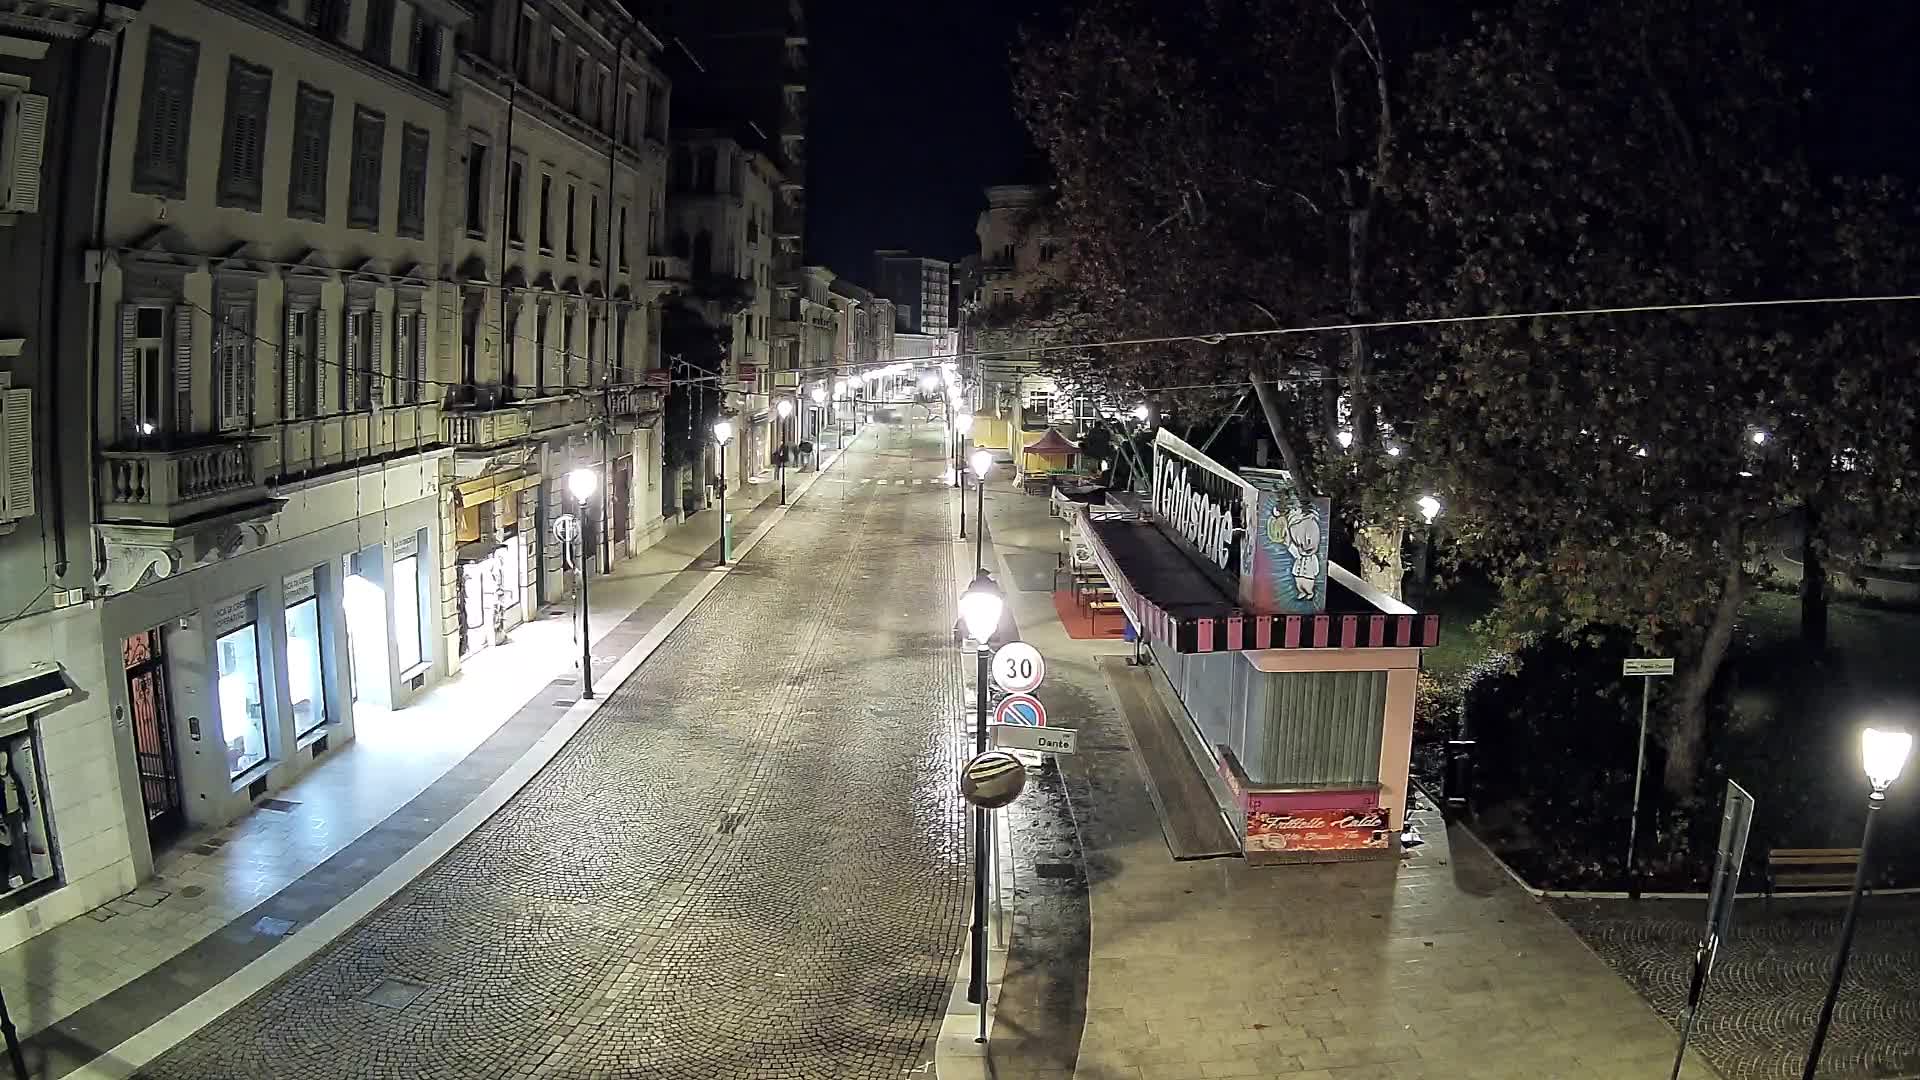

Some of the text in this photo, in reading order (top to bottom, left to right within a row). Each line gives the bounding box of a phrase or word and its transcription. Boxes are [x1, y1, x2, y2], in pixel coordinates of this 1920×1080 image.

[1162, 458, 1233, 570] Golosone
[1006, 658, 1032, 678] 30
[1038, 737, 1069, 748] Dante
[1330, 815, 1382, 829] Calde
